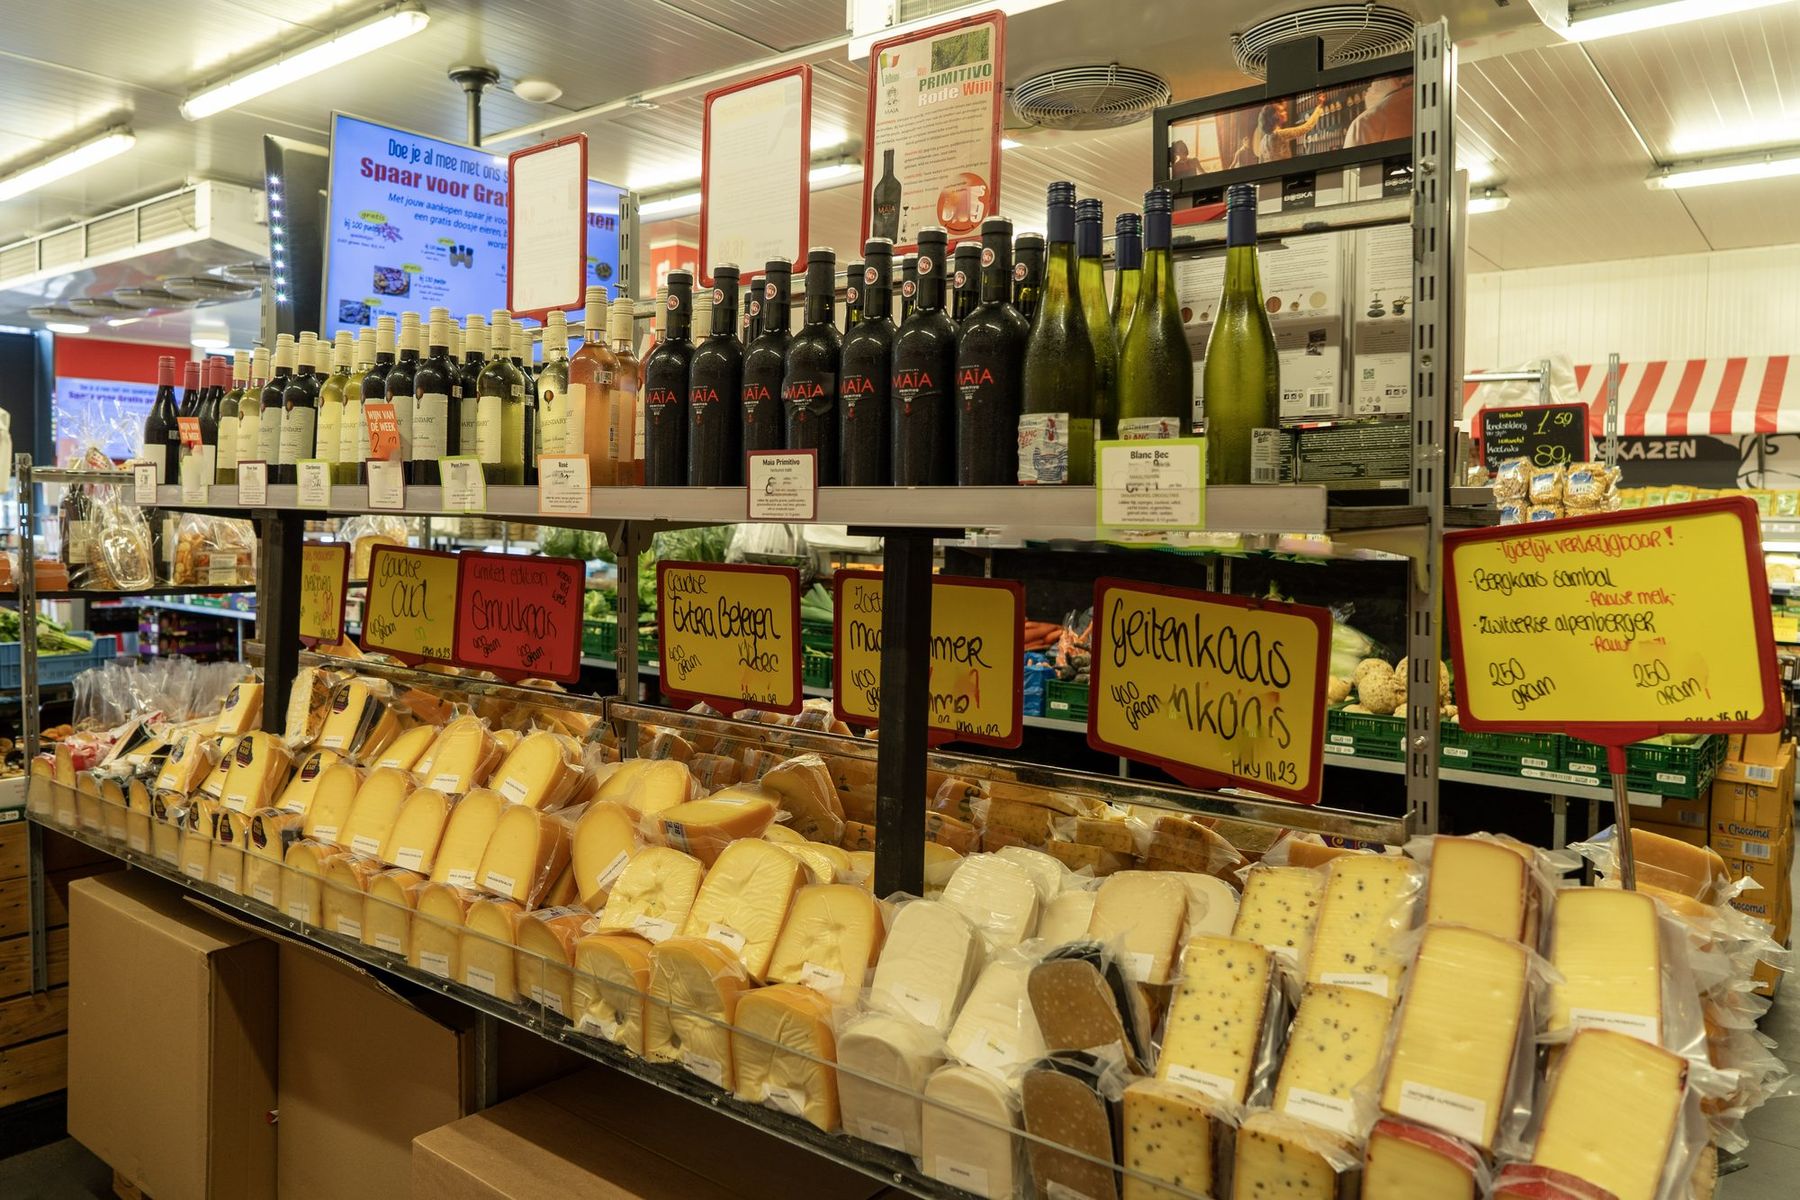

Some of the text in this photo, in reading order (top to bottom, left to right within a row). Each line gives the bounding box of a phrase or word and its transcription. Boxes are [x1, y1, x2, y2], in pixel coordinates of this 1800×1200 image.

[919, 63, 992, 92] PRIMITIVO
[917, 80, 993, 107] Rode Wijn
[388, 138, 408, 159] Doe
[409, 144, 420, 165] je
[424, 149, 433, 165] al
[435, 153, 457, 171] mee
[459, 159, 480, 177] met
[483, 167, 500, 181] ons
[360, 156, 423, 189] Spaar
[426, 174, 470, 199] voor
[388, 192, 404, 202] Met
[404, 195, 424, 207] jouw
[426, 202, 463, 216] aankopen
[464, 209, 485, 222] spaar
[485, 214, 493, 223] je
[414, 212, 429, 221] een
[429, 215, 452, 227] gratis
[453, 219, 478, 233] doosje
[367, 410, 395, 420] WIJN VAN
[370, 422, 396, 432] DE WEEK
[1130, 450, 1169, 459] Blanc Bec
[1473, 568, 1549, 596] Bergkaas
[673, 596, 718, 640] Extra
[1111, 598, 1291, 689] Geitenkaas
[1489, 657, 1525, 688] 250
[1632, 658, 1670, 688] 250
[1111, 681, 1140, 707] 400
[1512, 675, 1556, 710] gram
[1126, 693, 1162, 731] gram
